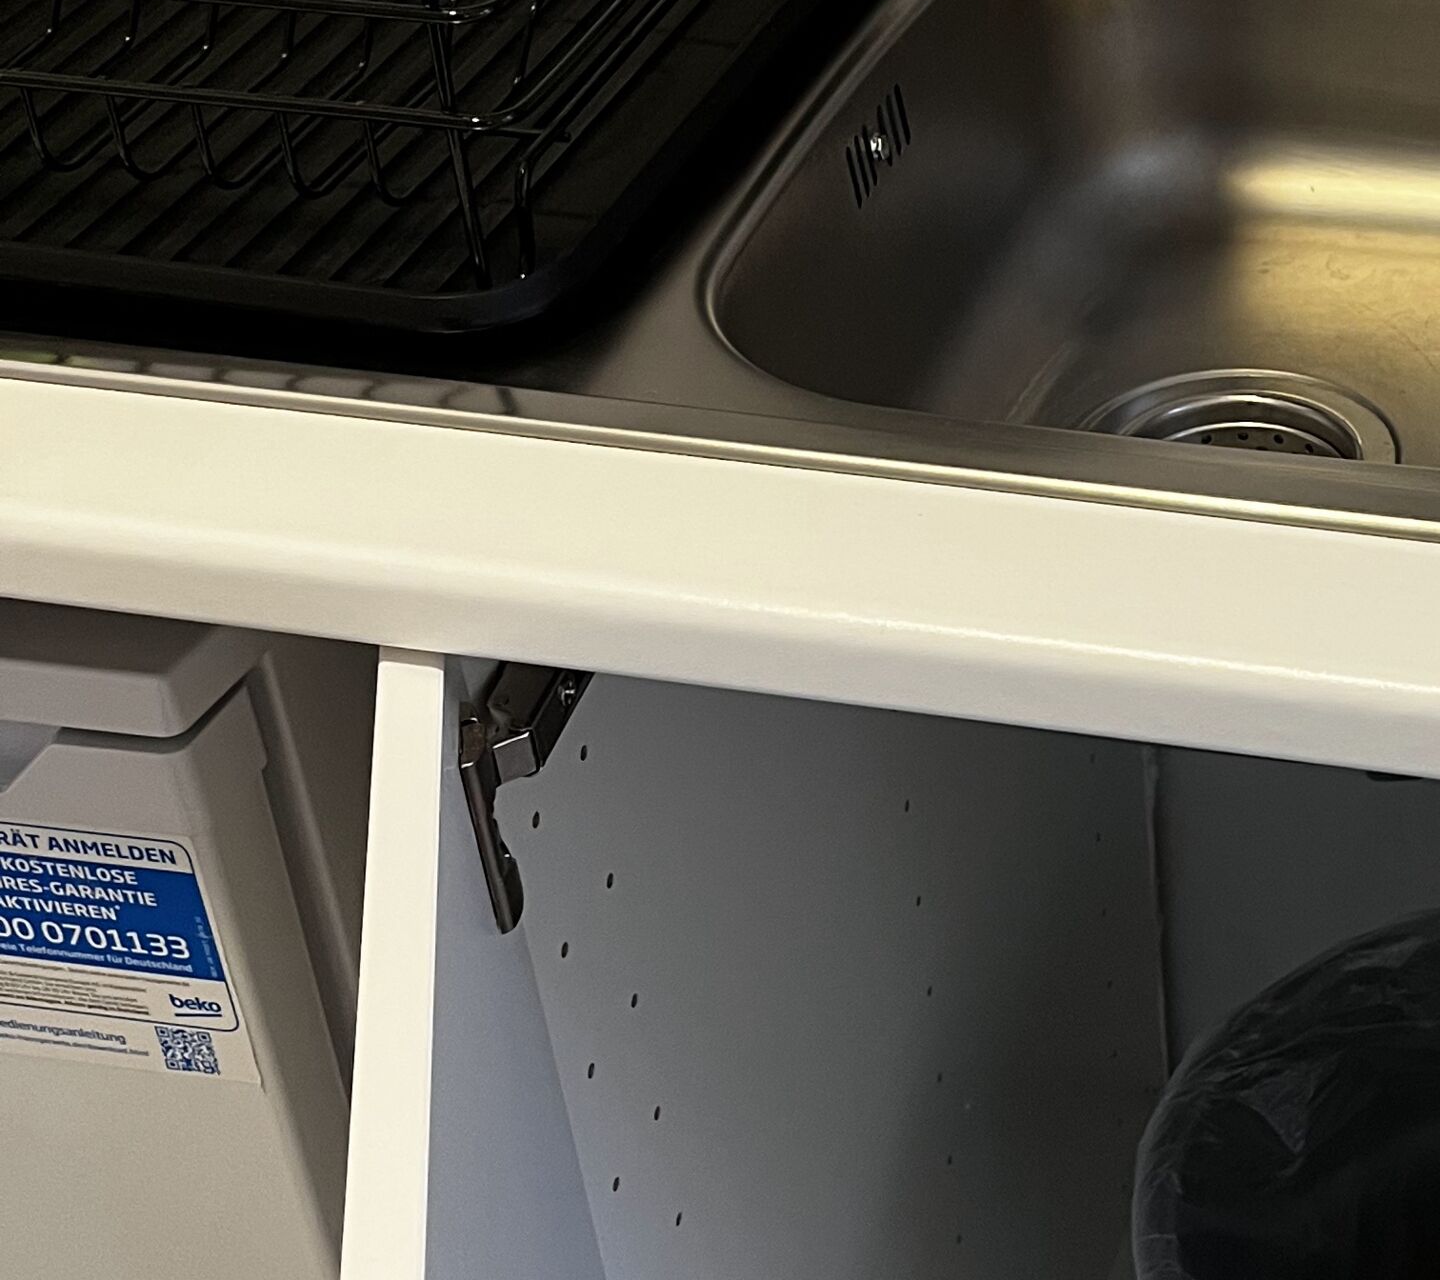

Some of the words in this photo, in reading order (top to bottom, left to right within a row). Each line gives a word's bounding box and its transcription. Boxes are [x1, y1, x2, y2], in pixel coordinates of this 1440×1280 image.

[48, 836, 177, 865] ANMELDEN
[0, 856, 138, 885] KOSTENLOSE
[0, 876, 158, 907] RES-GARANTIE
[41, 921, 190, 960] 0701133
[124, 956, 193, 973] Deutschland
[168, 993, 222, 1013] beko
